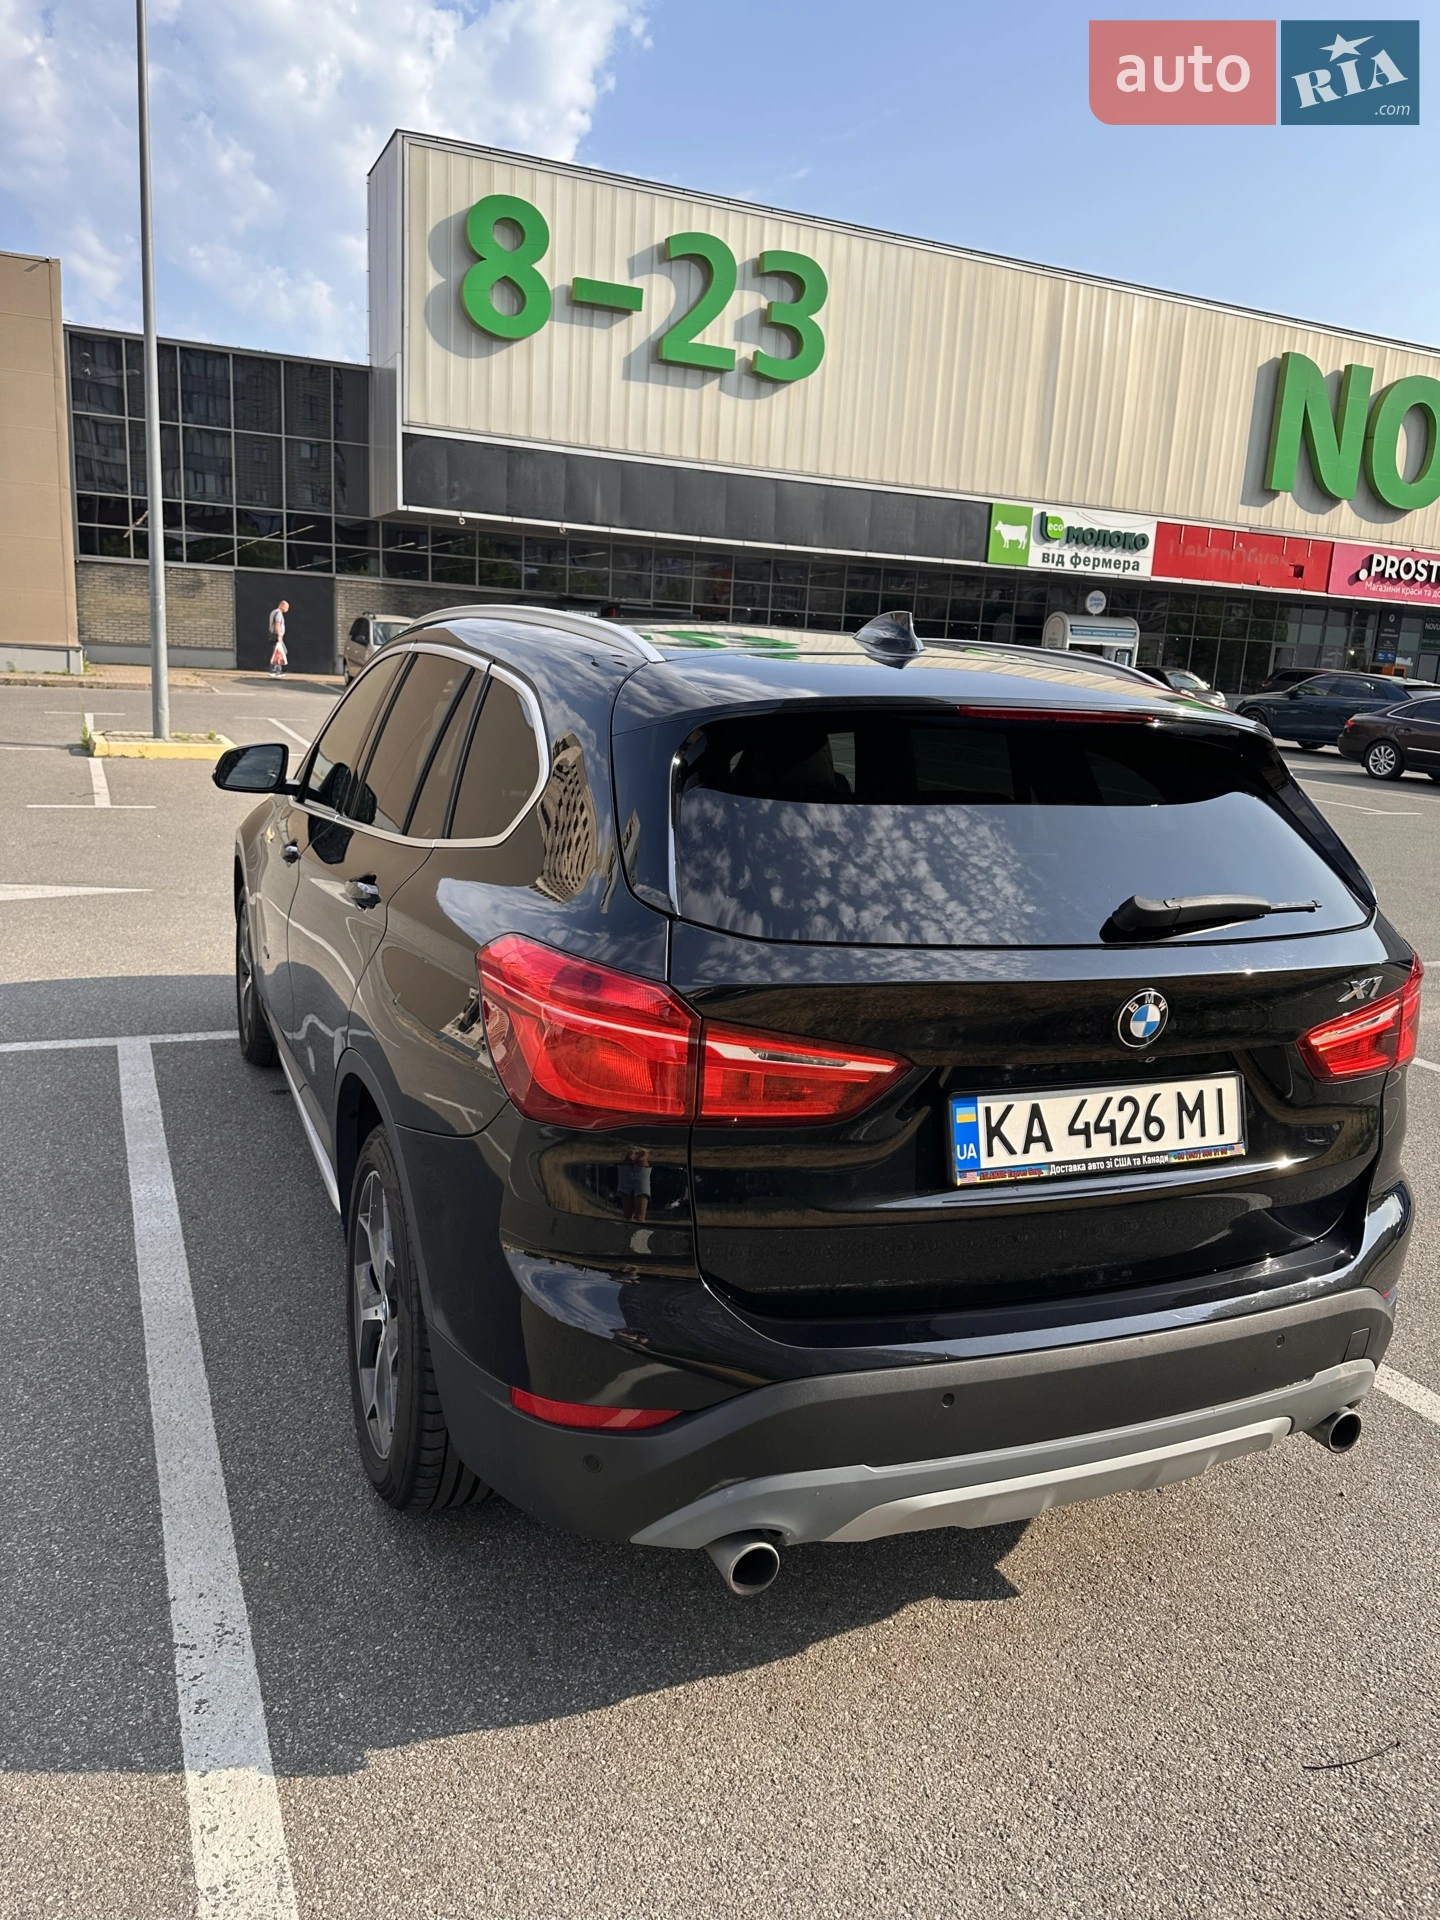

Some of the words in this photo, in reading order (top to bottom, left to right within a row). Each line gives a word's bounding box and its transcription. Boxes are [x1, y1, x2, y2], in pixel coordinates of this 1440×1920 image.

[1264, 351, 1440, 511] NO
[1048, 522, 1064, 532] eco
[1041, 552, 1065, 568] від
[1069, 552, 1141, 573] фермера
[1365, 580, 1401, 593] Магазини
[1401, 587, 1423, 597] краси
[1424, 589, 1432, 597] та
[1337, 976, 1384, 1003] X1
[1127, 991, 1169, 1013] BMW
[984, 1103, 1054, 1158] KA
[1068, 1093, 1166, 1149] 4426
[1176, 1087, 1226, 1140] MI
[956, 1142, 978, 1161] UA
[1049, 1160, 1087, 1176] Доставка
[1087, 1161, 1105, 1171] авто
[1106, 1159, 1114, 1169] зі
[1114, 1156, 1132, 1168] США
[1132, 1157, 1141, 1166] та
[1141, 1153, 1170, 1165] Канади
